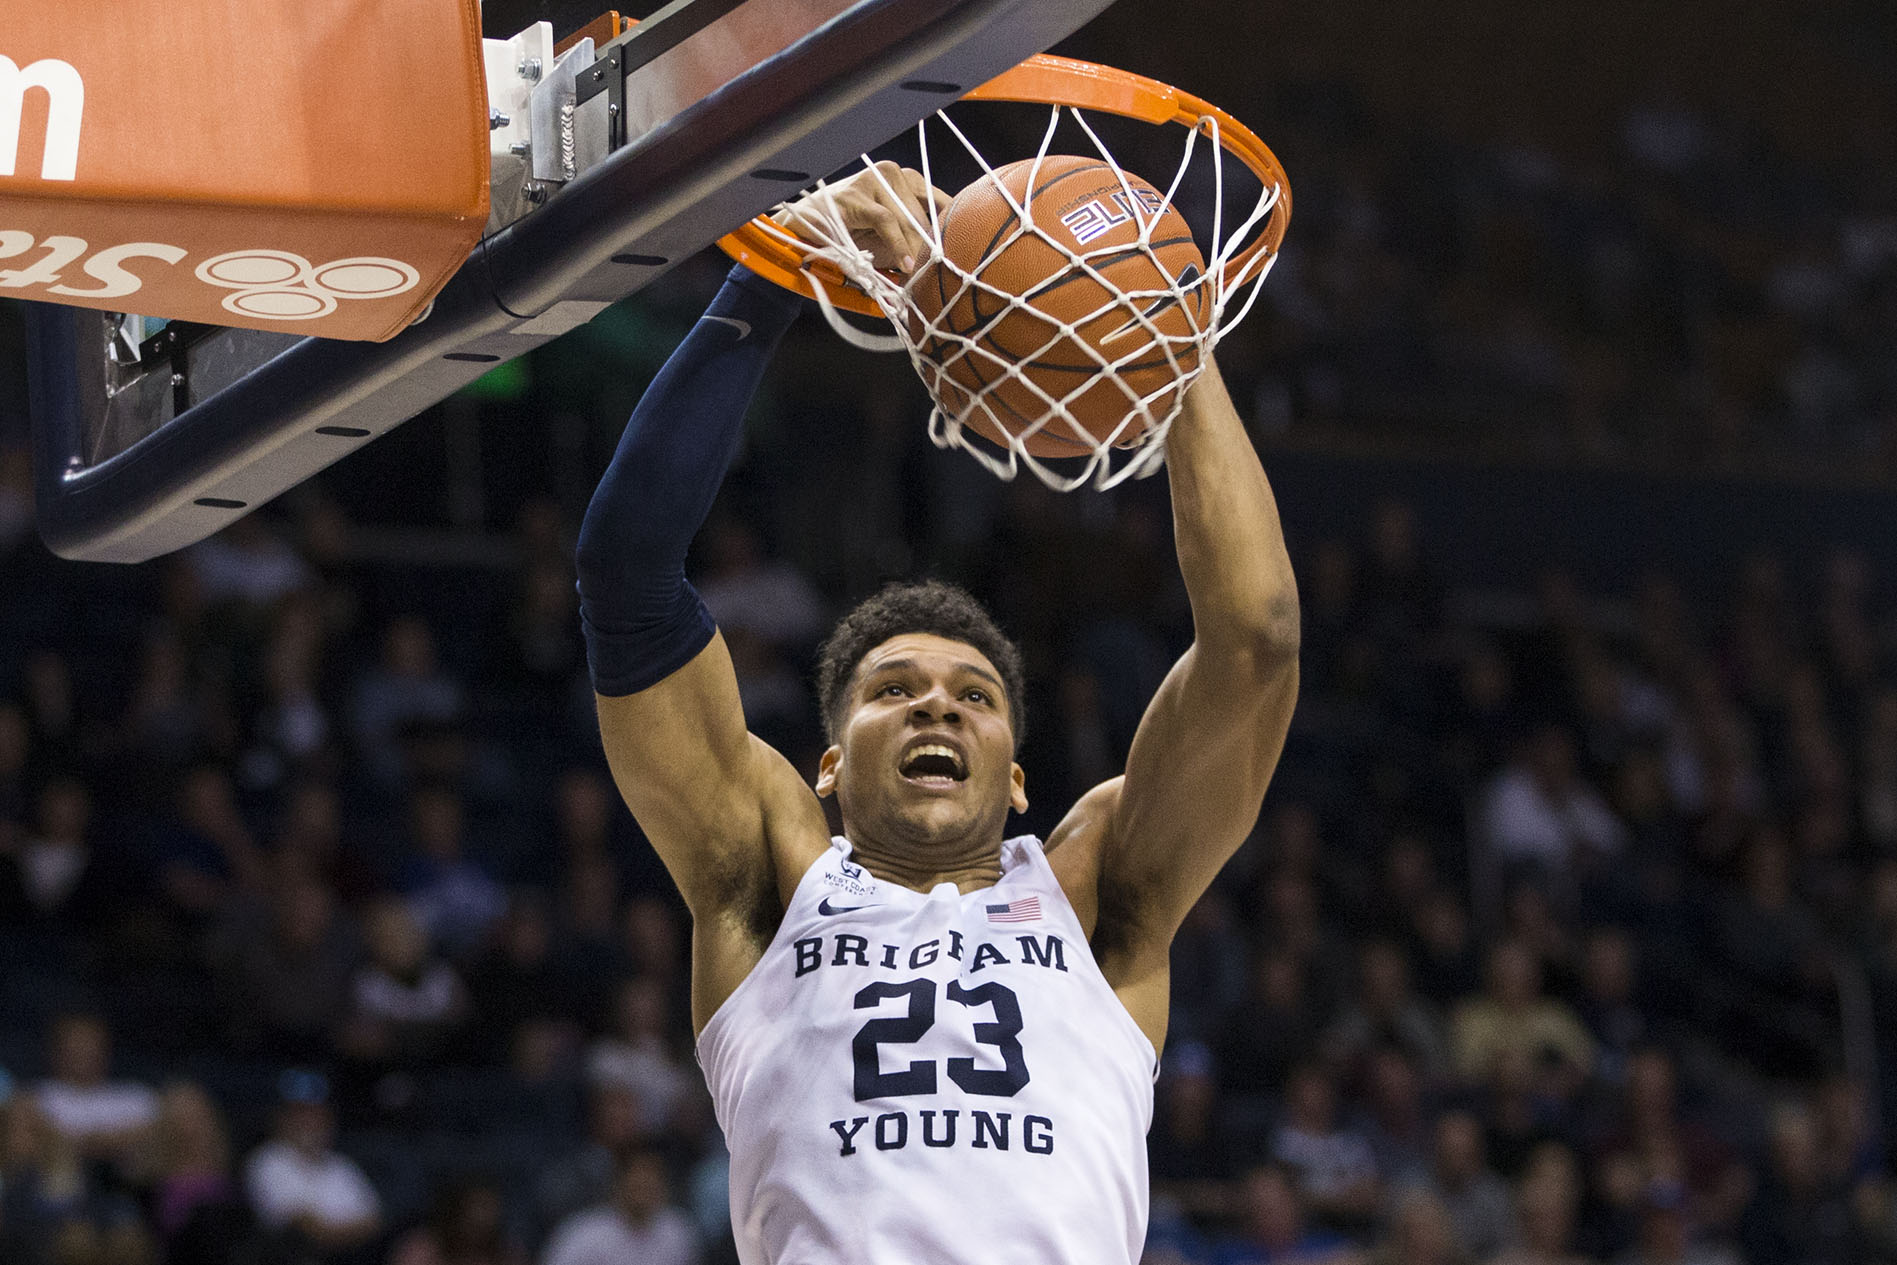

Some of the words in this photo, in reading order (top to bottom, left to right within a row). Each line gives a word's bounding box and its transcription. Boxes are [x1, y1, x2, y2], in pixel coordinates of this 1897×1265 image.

[1056, 181, 1150, 217] PIONSHIP
[1061, 189, 1171, 245] ELITE
[825, 872, 848, 884] WEST
[852, 978, 1030, 1103] 23
[830, 1109, 1054, 1157] YOUNG
